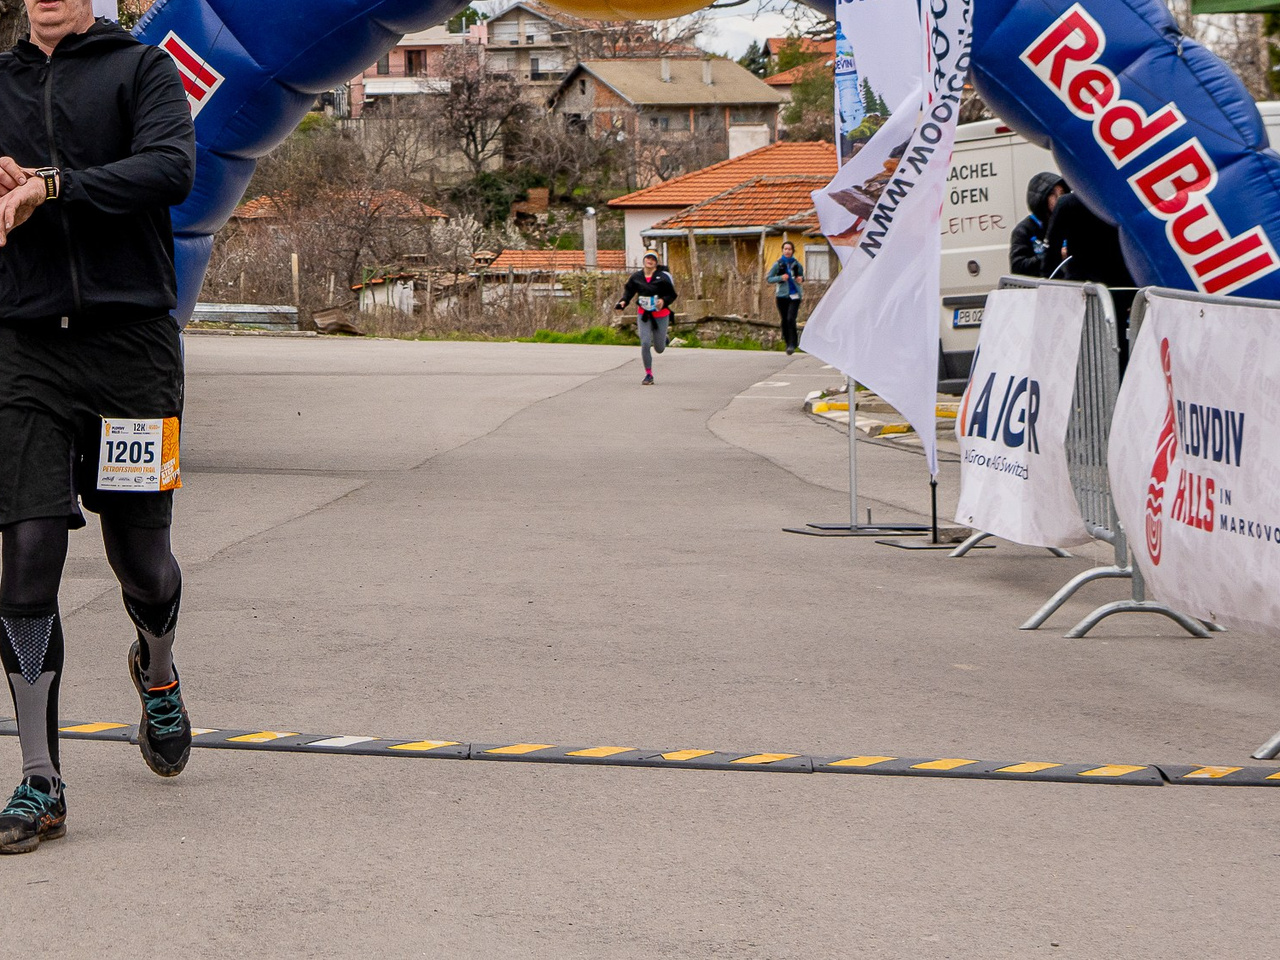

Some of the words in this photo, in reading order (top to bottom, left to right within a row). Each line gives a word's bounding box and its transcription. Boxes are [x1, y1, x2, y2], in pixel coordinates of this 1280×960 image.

[1024, 7, 1181, 165] Red
[1132, 141, 1277, 296] Bull
[946, 162, 998, 182] ACHEL
[950, 187, 989, 205] ÖFEN
[133, 423, 146, 432] 12K
[106, 440, 155, 464] 1205
[1171, 467, 1215, 533] HILLS
[1219, 488, 1232, 506] IN
